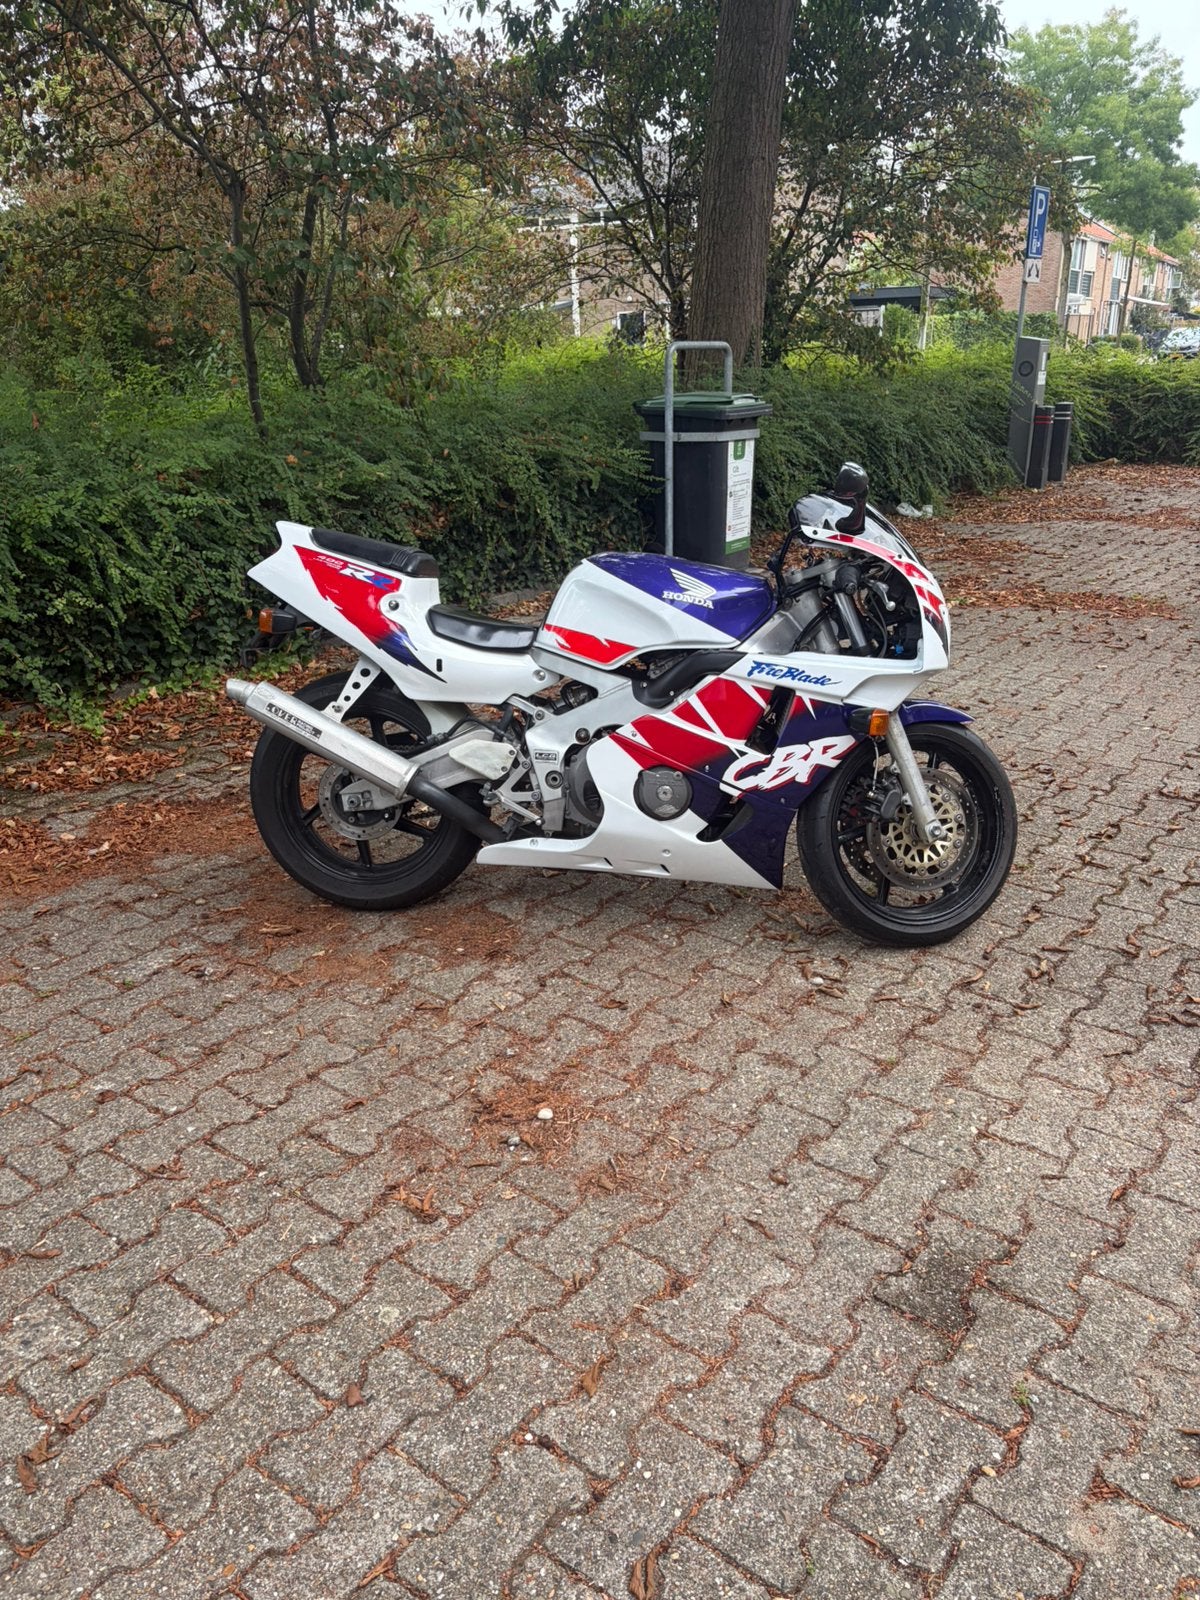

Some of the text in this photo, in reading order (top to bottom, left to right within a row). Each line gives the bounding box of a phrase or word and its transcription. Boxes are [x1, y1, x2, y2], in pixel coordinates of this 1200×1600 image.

[1034, 192, 1046, 228] P
[662, 590, 714, 610] HONDA
[719, 735, 856, 798] CBR
